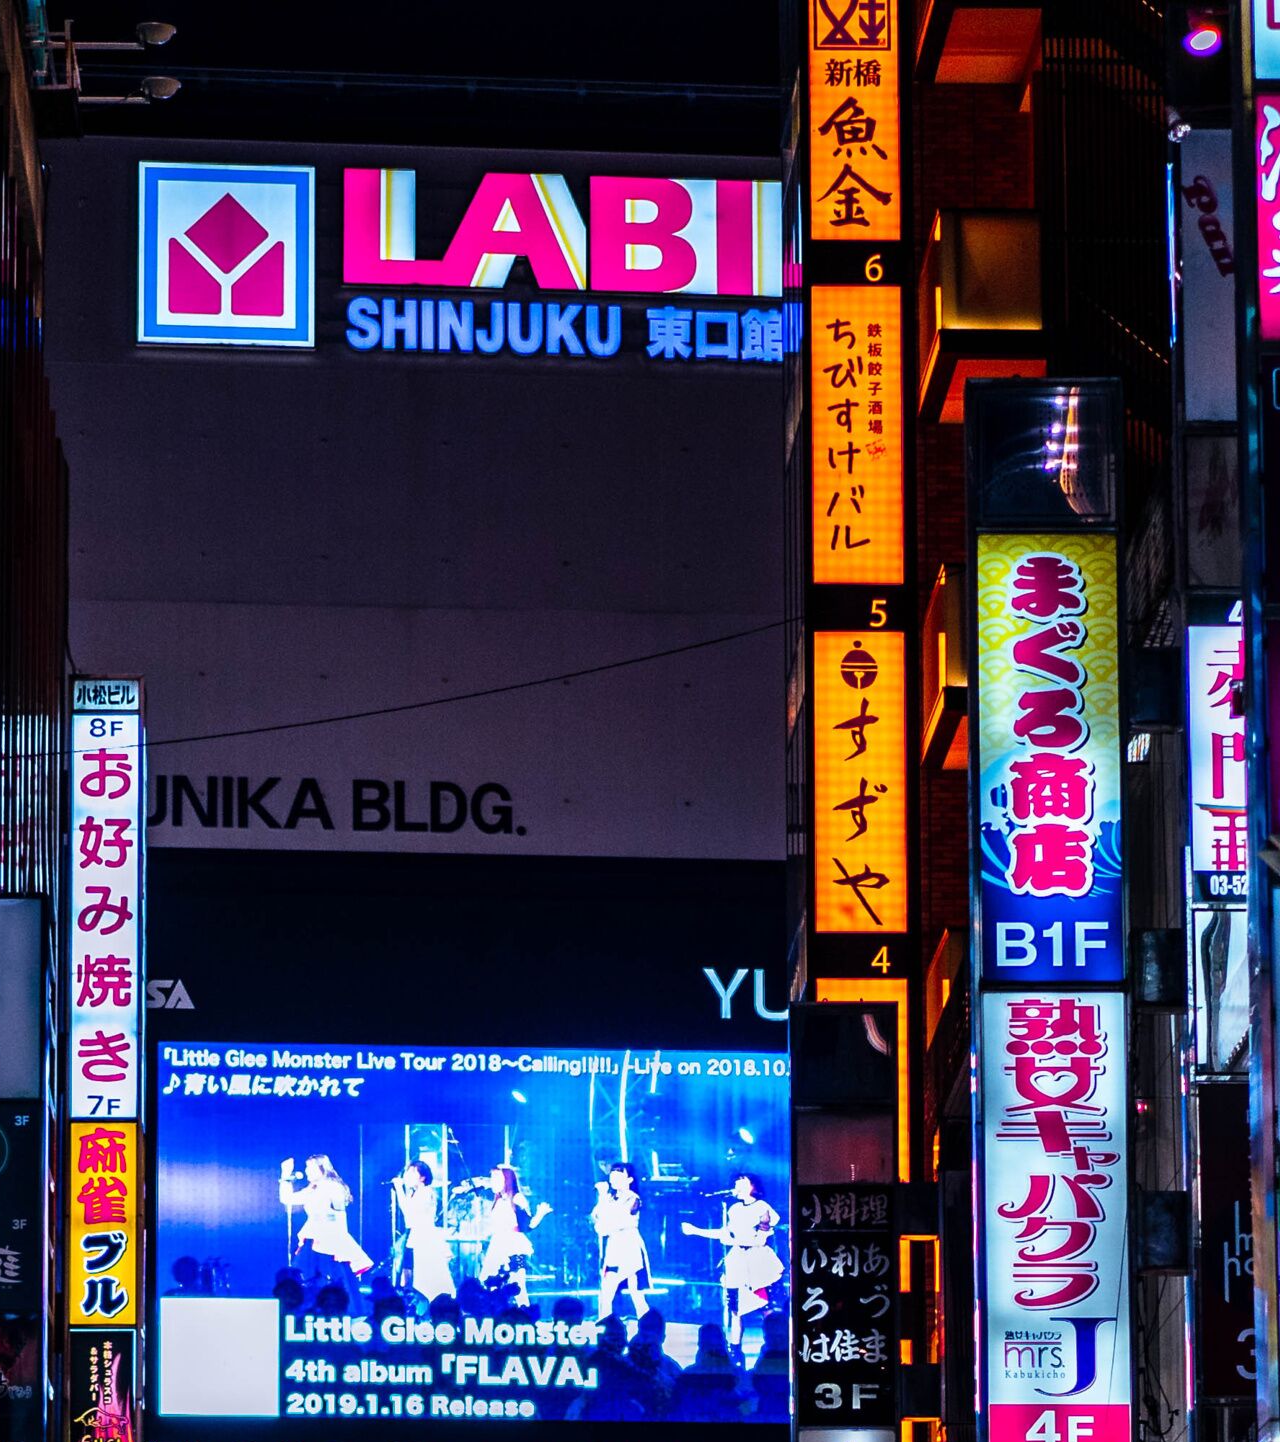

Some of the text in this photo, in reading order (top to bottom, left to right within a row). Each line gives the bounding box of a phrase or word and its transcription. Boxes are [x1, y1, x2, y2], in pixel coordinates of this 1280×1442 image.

[825, 59, 881, 87] 新橋
[818, 97, 892, 228] 魚金
[343, 167, 783, 296] LABI
[864, 255, 883, 281] 6
[346, 296, 785, 362] SHINJUKU 東口館
[867, 323, 883, 434] 鉄板餃子酒場
[822, 319, 870, 550] ちびすけバル
[869, 600, 887, 627] 5
[76, 685, 136, 706] 小松ビル
[89, 717, 125, 738] 8F
[1009, 554, 1092, 895] まぐろ商店
[352, 779, 526, 836] BLDG.
[832, 698, 889, 926] すずや
[77, 747, 133, 1083] お好み焼き
[870, 946, 890, 973] 4
[996, 921, 1109, 967] B1F
[225, 1051, 700, 1074] Glee Monster Live Tour on
[14, 1115, 30, 1126] 3F
[86, 1095, 121, 1116] 7F
[995, 998, 1120, 1310] 熟女キャバクラ
[802, 1193, 888, 1227] 小料理
[801, 1247, 830, 1365] いろは
[285, 1316, 604, 1346] Little Glee Monster
[1034, 1316, 1118, 1397] J
[286, 1361, 433, 1385] 4th album
[1005, 1370, 1066, 1380] Kabukicho
[287, 1394, 535, 1418] 2019.1.16 Release
[814, 1383, 880, 1409] 3F
